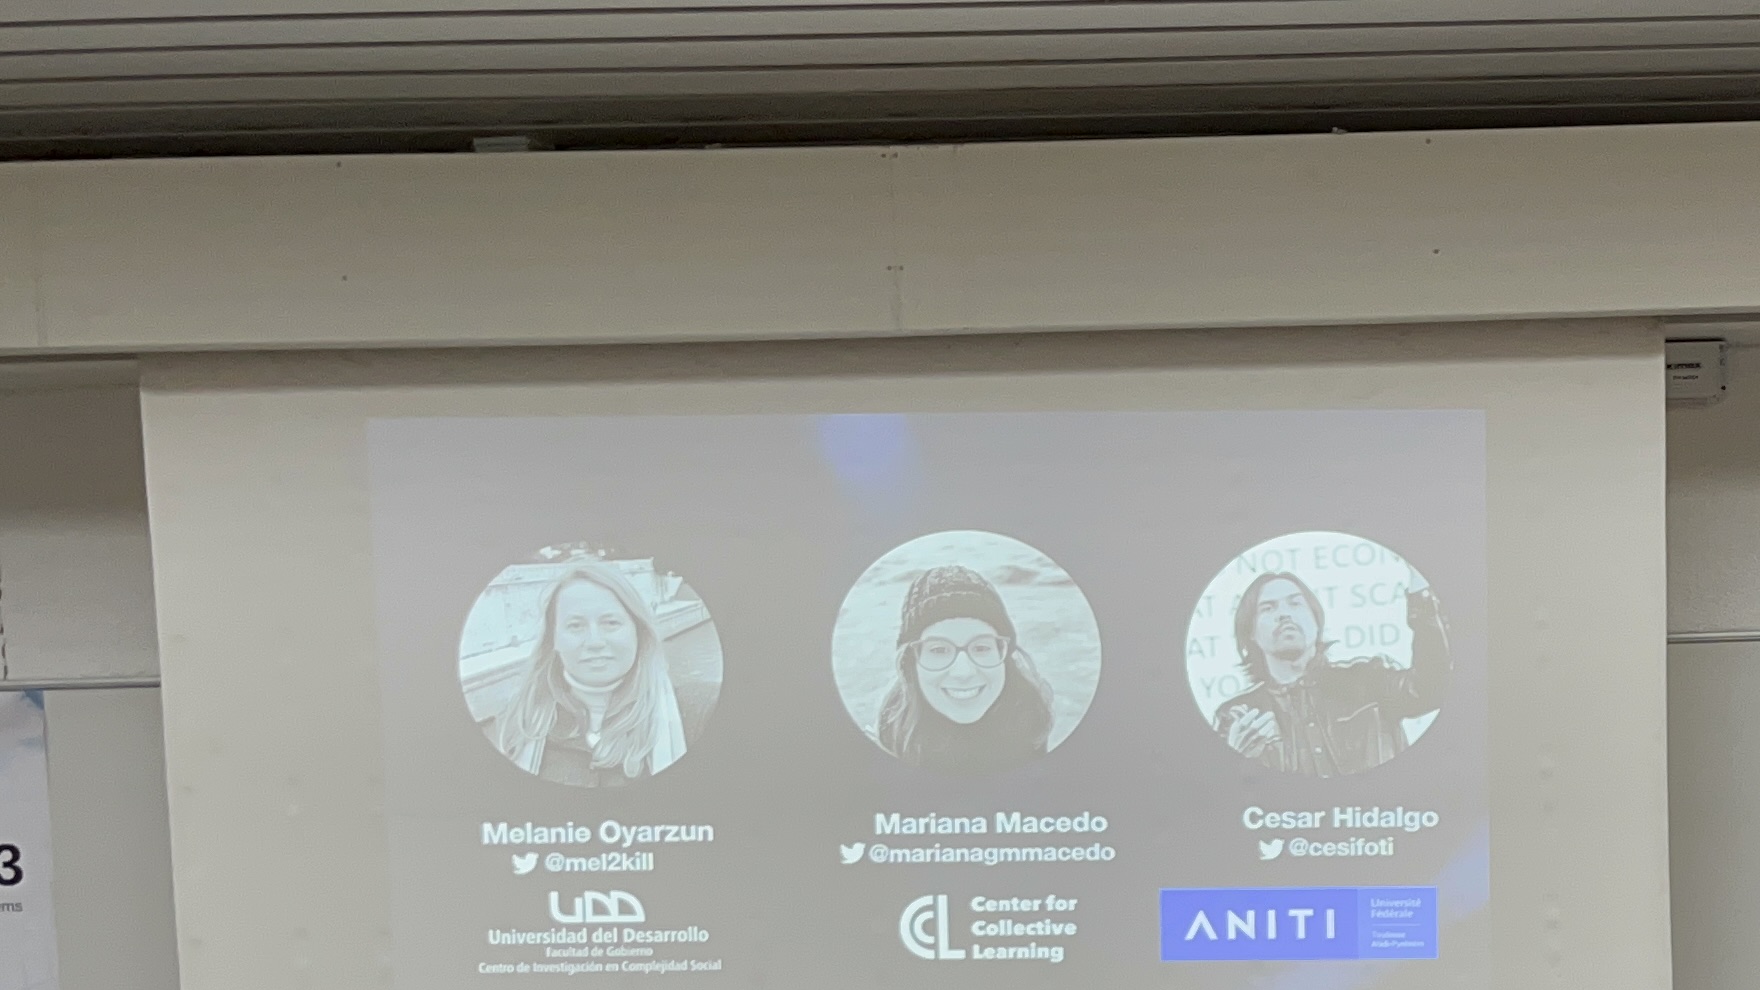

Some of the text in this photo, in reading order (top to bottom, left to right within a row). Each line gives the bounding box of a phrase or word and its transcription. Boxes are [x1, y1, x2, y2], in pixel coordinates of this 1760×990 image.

[1344, 623, 1400, 649] DID
[874, 811, 1108, 835] Mariana Macedo
[1243, 806, 1439, 832] Cesar Hidalgo
[481, 820, 714, 848] Melanie Oyarzun
[869, 842, 1116, 866] @marianagmmacedo
[1289, 837, 1394, 857] @cesifoti
[545, 852, 654, 872] @mel2kill
[549, 890, 645, 923] UDD
[970, 894, 1078, 912] Center for
[488, 926, 709, 944] Universidad del Desarrollo
[971, 919, 1077, 936] Collective
[1184, 908, 1335, 941] ANITI
[591, 946, 603, 957] de
[972, 942, 1064, 963] Learning
[479, 960, 722, 975] Centro de Investigación en Complejidad Social
